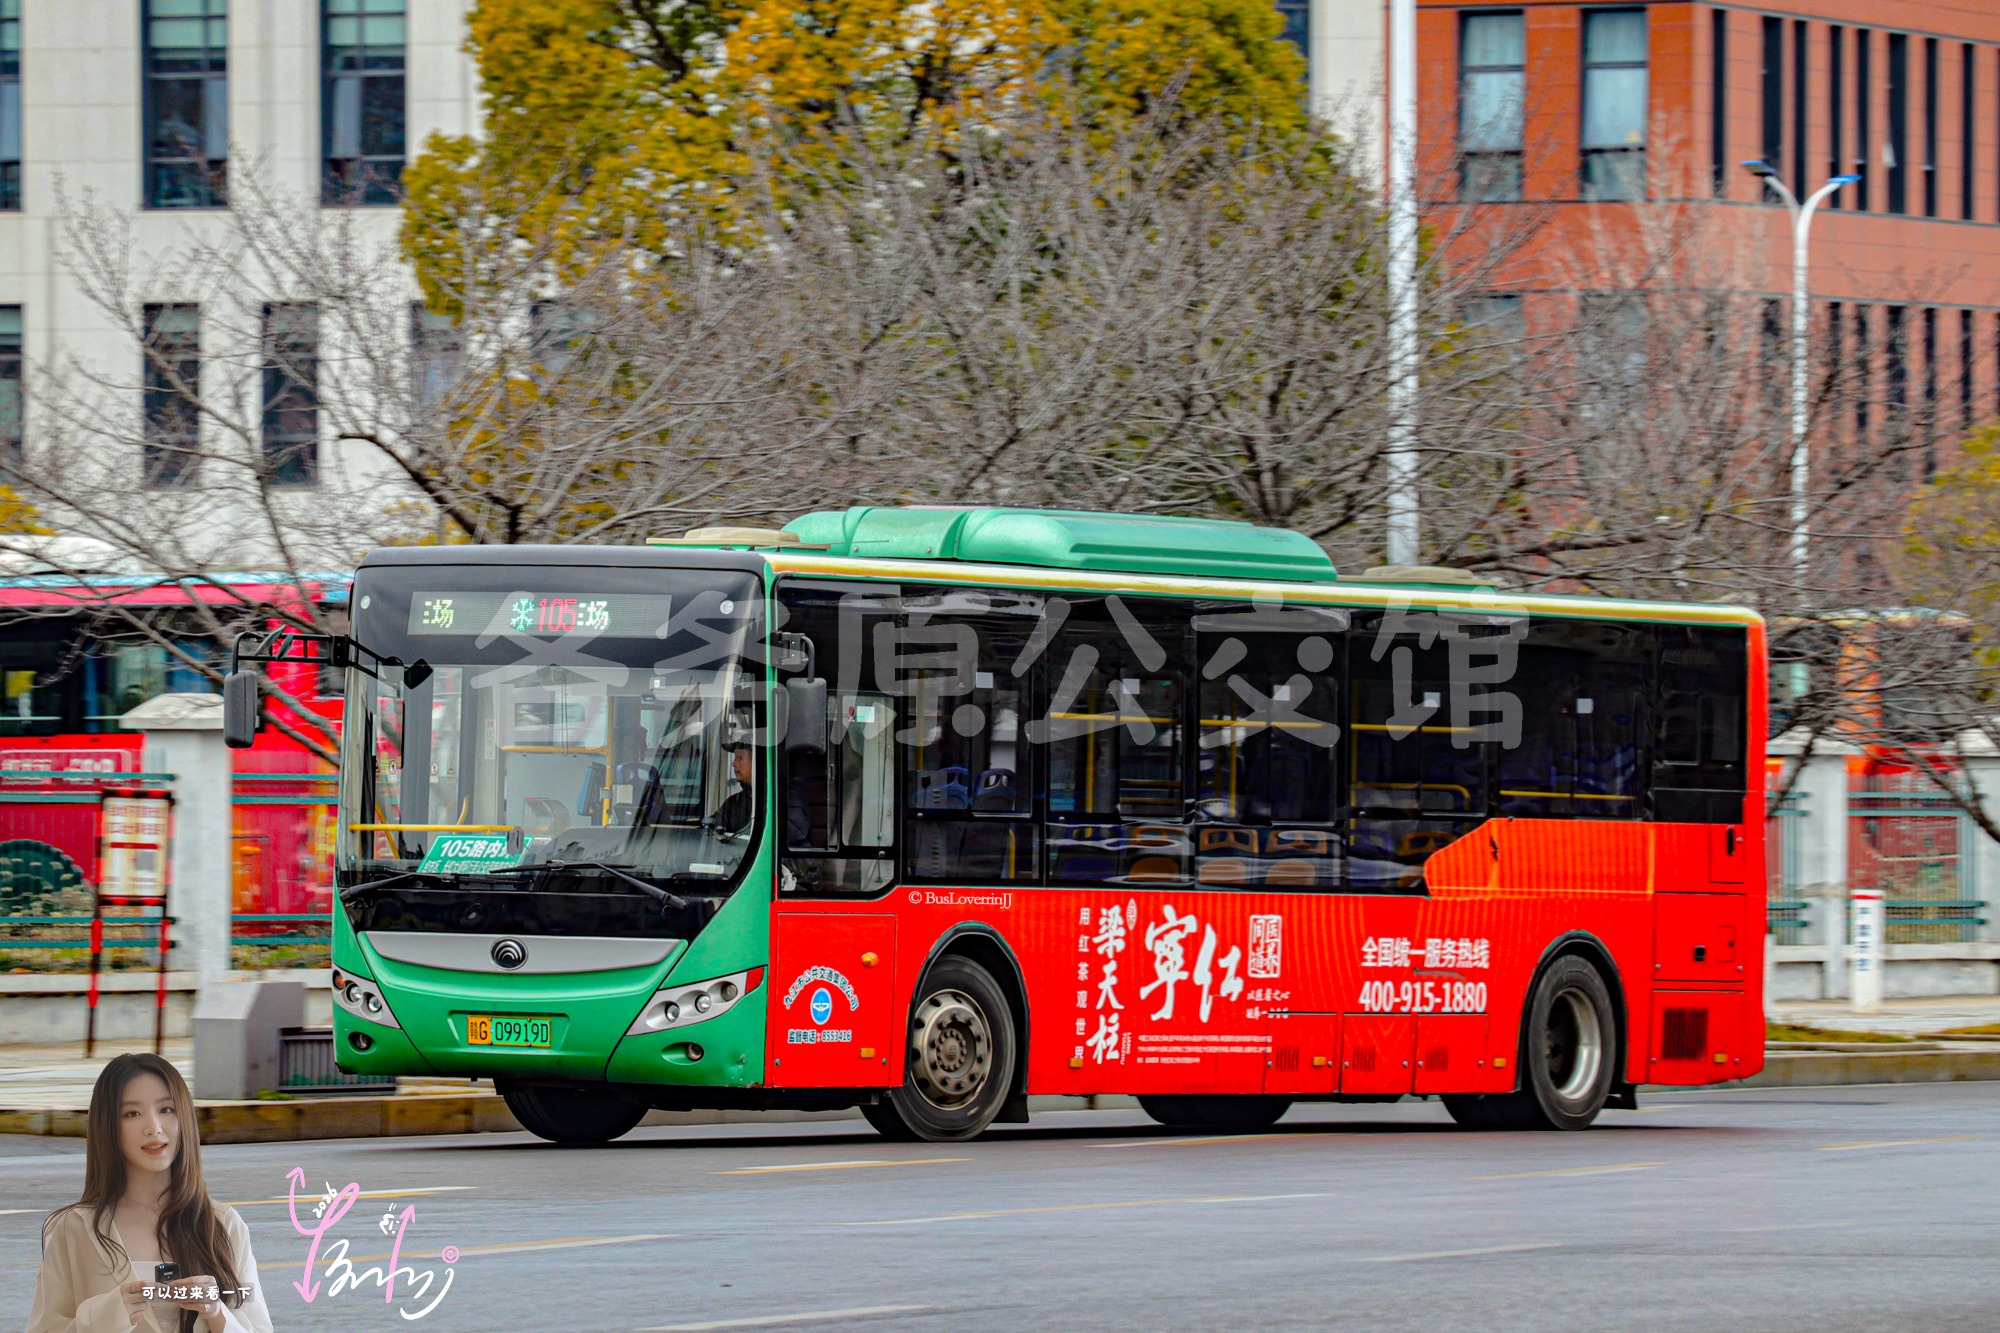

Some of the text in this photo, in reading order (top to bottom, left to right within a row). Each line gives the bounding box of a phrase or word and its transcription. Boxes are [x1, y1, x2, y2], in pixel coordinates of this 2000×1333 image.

[538, 598, 577, 632] 105
[1361, 936, 1490, 968] 全国统一服务热线
[1358, 980, 1488, 1013] 400-915-1880
